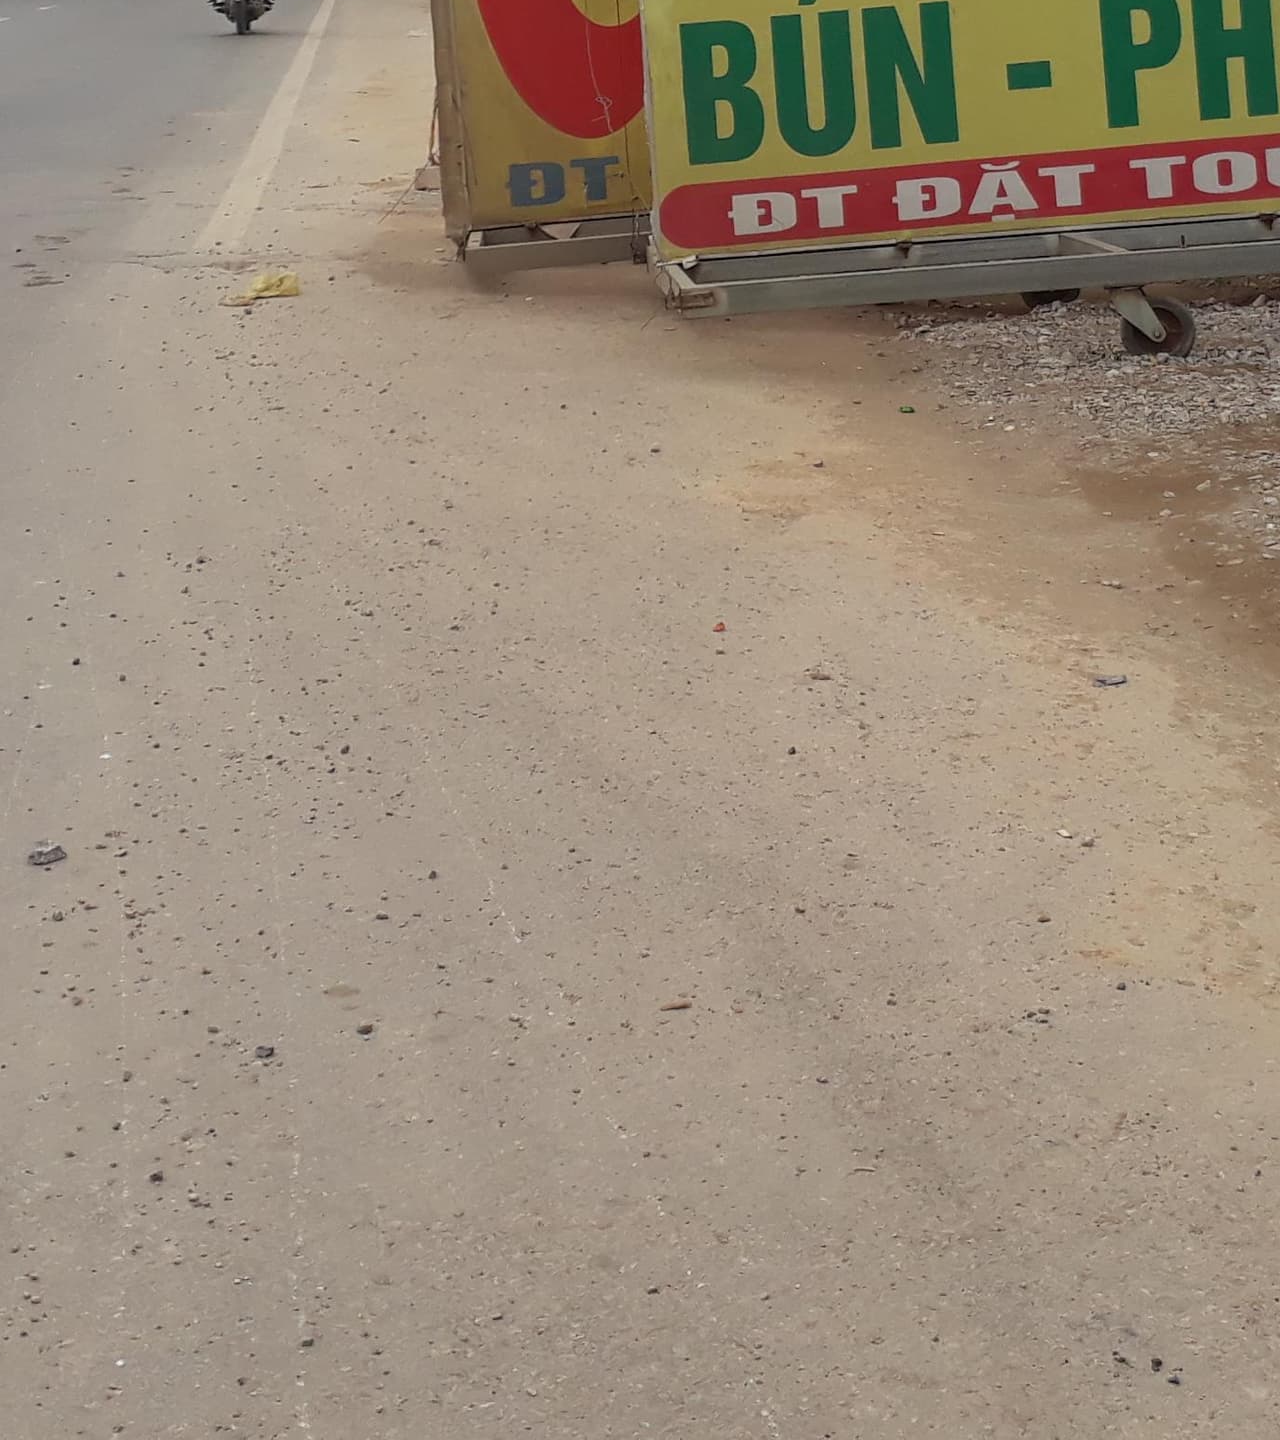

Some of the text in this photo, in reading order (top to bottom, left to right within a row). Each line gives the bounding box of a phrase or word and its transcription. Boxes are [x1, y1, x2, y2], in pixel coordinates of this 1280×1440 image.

[506, 156, 619, 207] ĐT
[727, 184, 858, 237] ĐT
[892, 161, 1096, 222] ĐẶT
